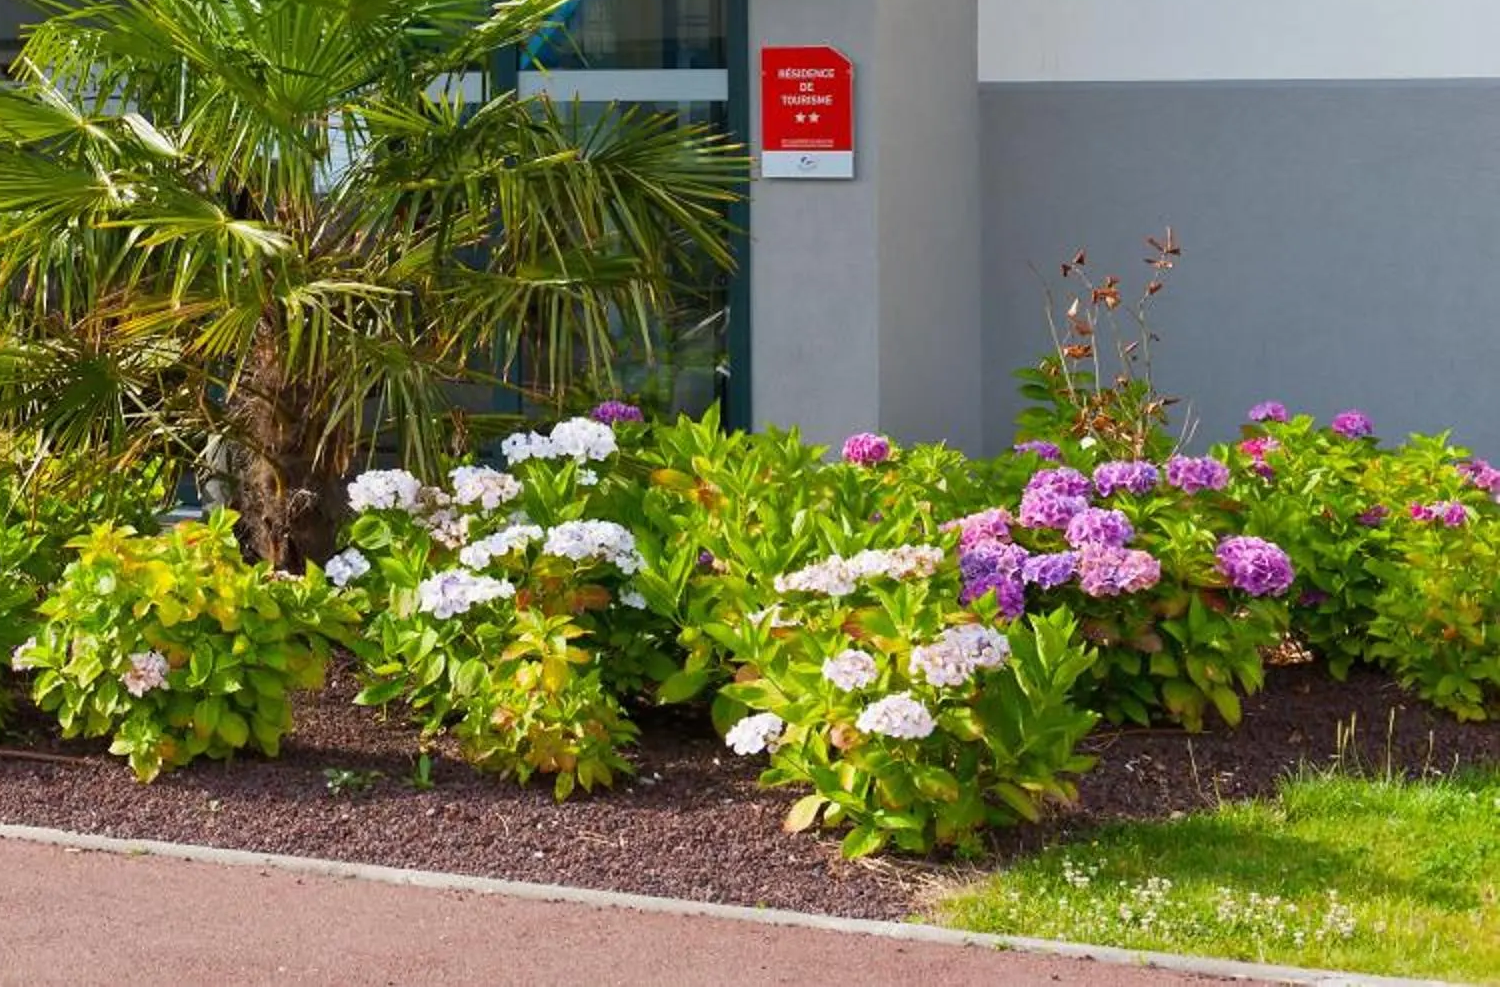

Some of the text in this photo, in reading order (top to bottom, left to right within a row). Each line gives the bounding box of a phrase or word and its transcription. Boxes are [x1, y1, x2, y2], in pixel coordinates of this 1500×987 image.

[777, 67, 835, 78] RÉSIDENCE
[799, 82, 814, 92] DE
[781, 95, 833, 106] TOURISME
